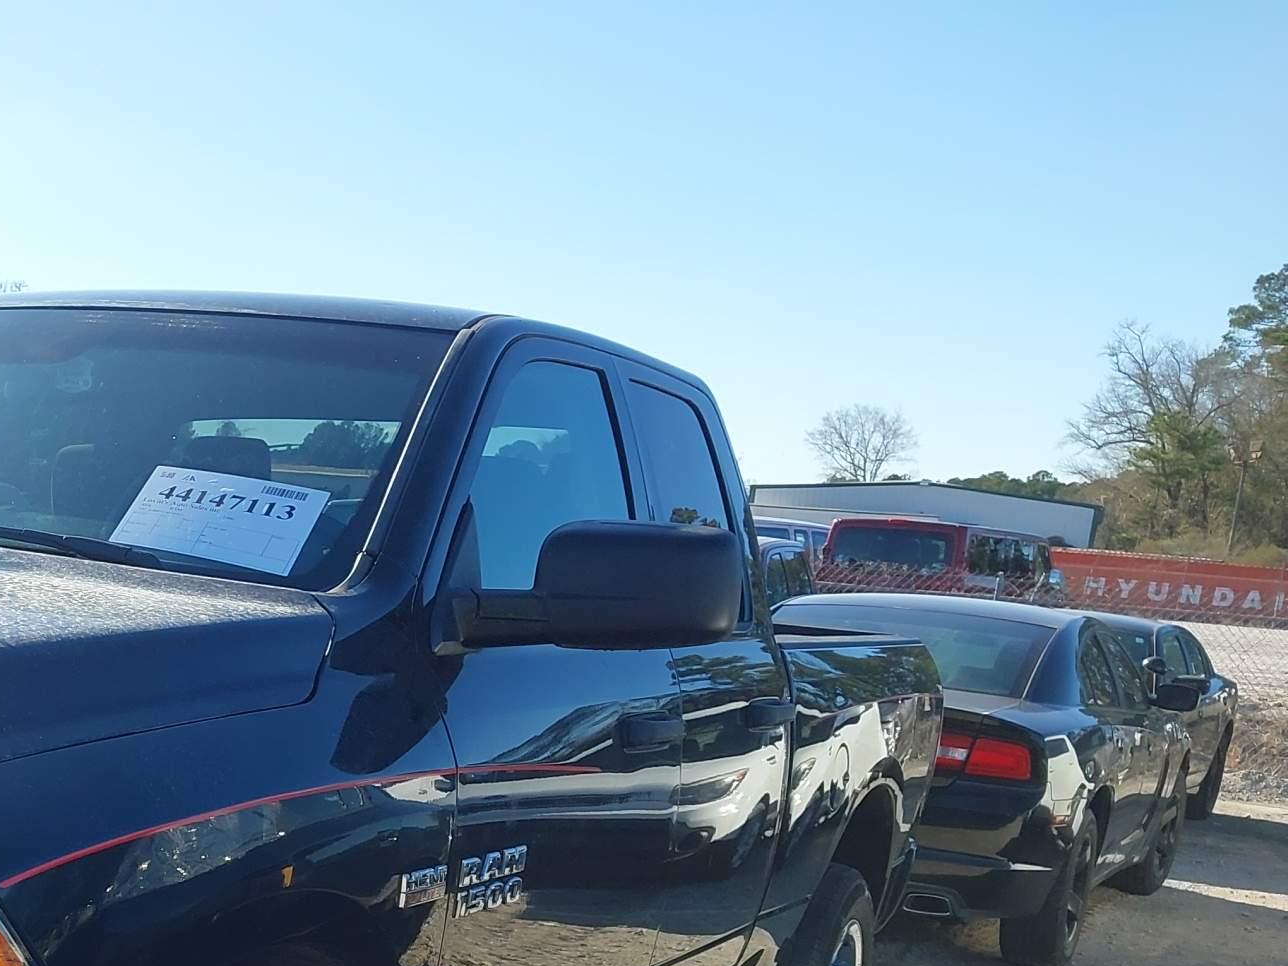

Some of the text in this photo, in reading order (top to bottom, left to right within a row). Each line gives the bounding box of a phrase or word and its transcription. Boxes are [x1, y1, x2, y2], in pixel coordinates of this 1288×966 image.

[158, 485, 297, 522] 44147113
[1084, 575, 1286, 611] HYUNDAI
[458, 844, 528, 888] RAM
[455, 876, 524, 919] 1500
